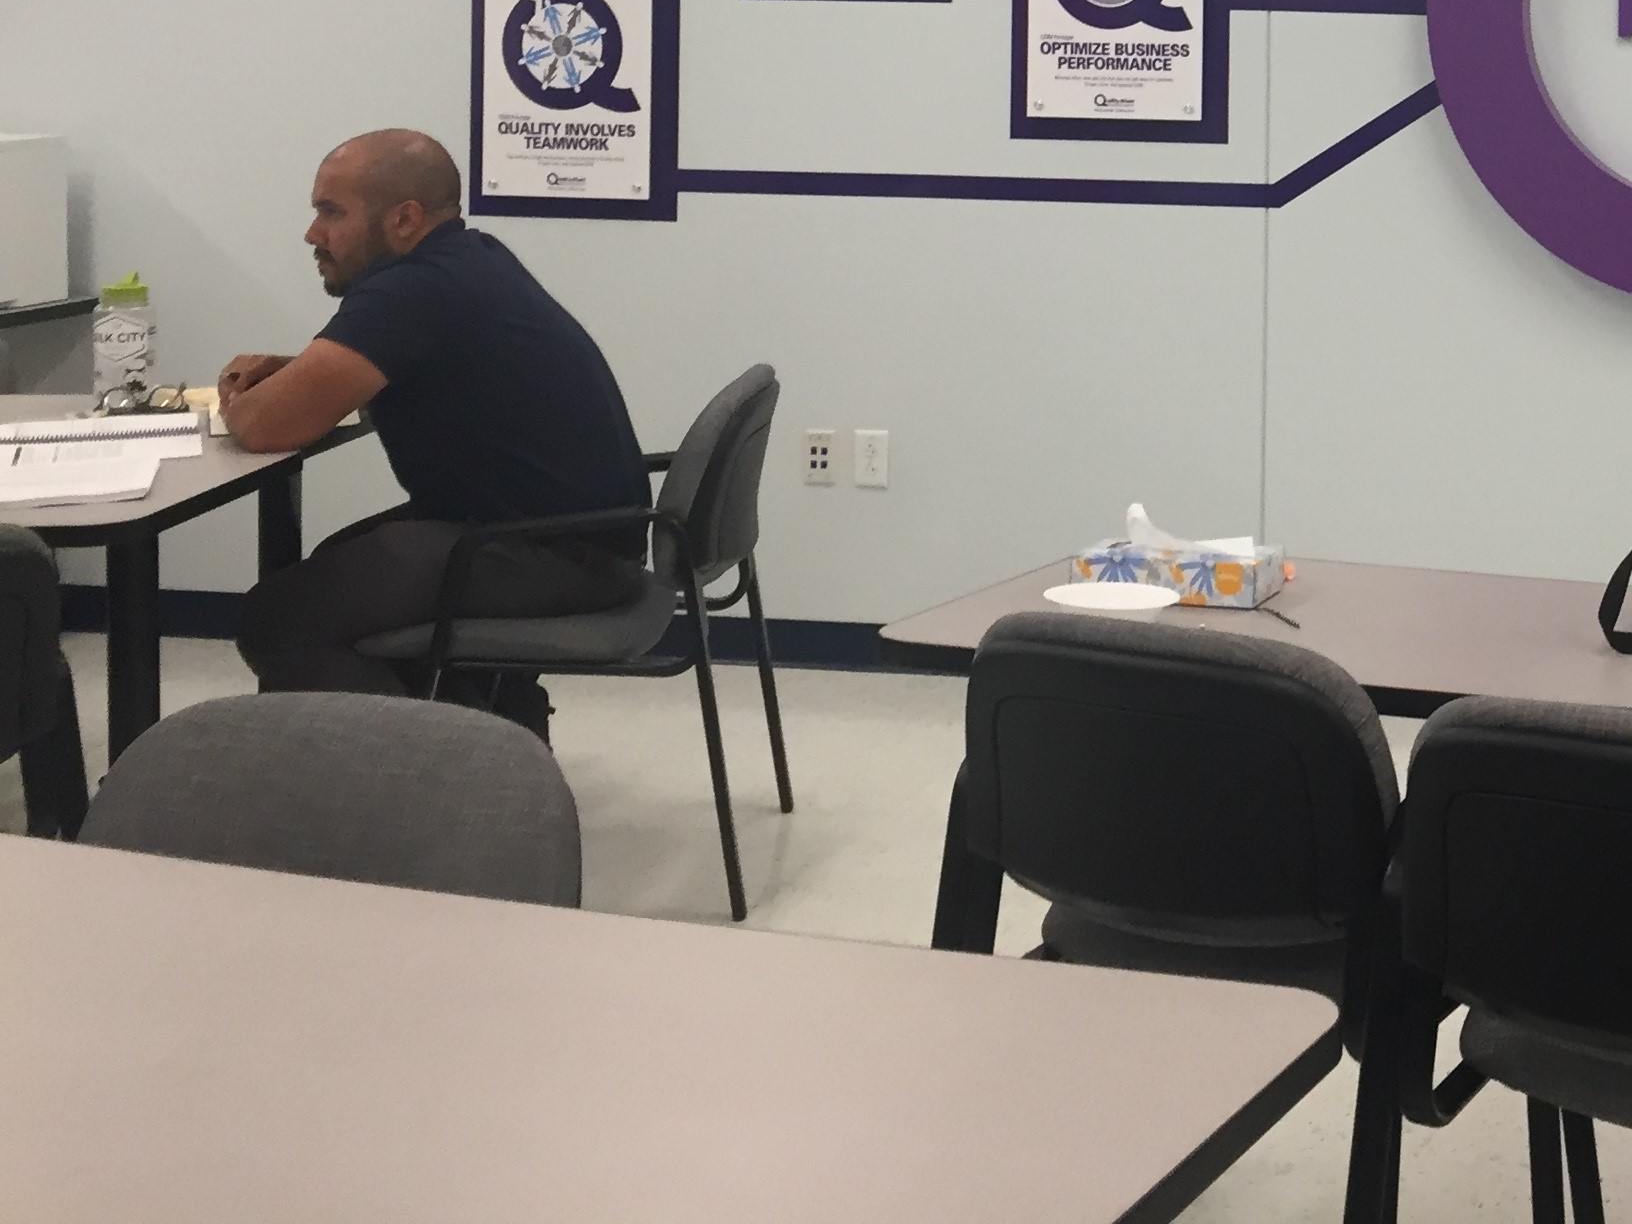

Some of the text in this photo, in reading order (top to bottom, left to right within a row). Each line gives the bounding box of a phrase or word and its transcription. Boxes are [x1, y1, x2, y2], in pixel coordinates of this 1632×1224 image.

[1040, 41, 1190, 57] OPTIMIZE BUSINESS
[1057, 57, 1173, 71] PERFORMANCE
[497, 121, 636, 138] QUALITY INVOLVES
[524, 136, 609, 151] TEAMWORK
